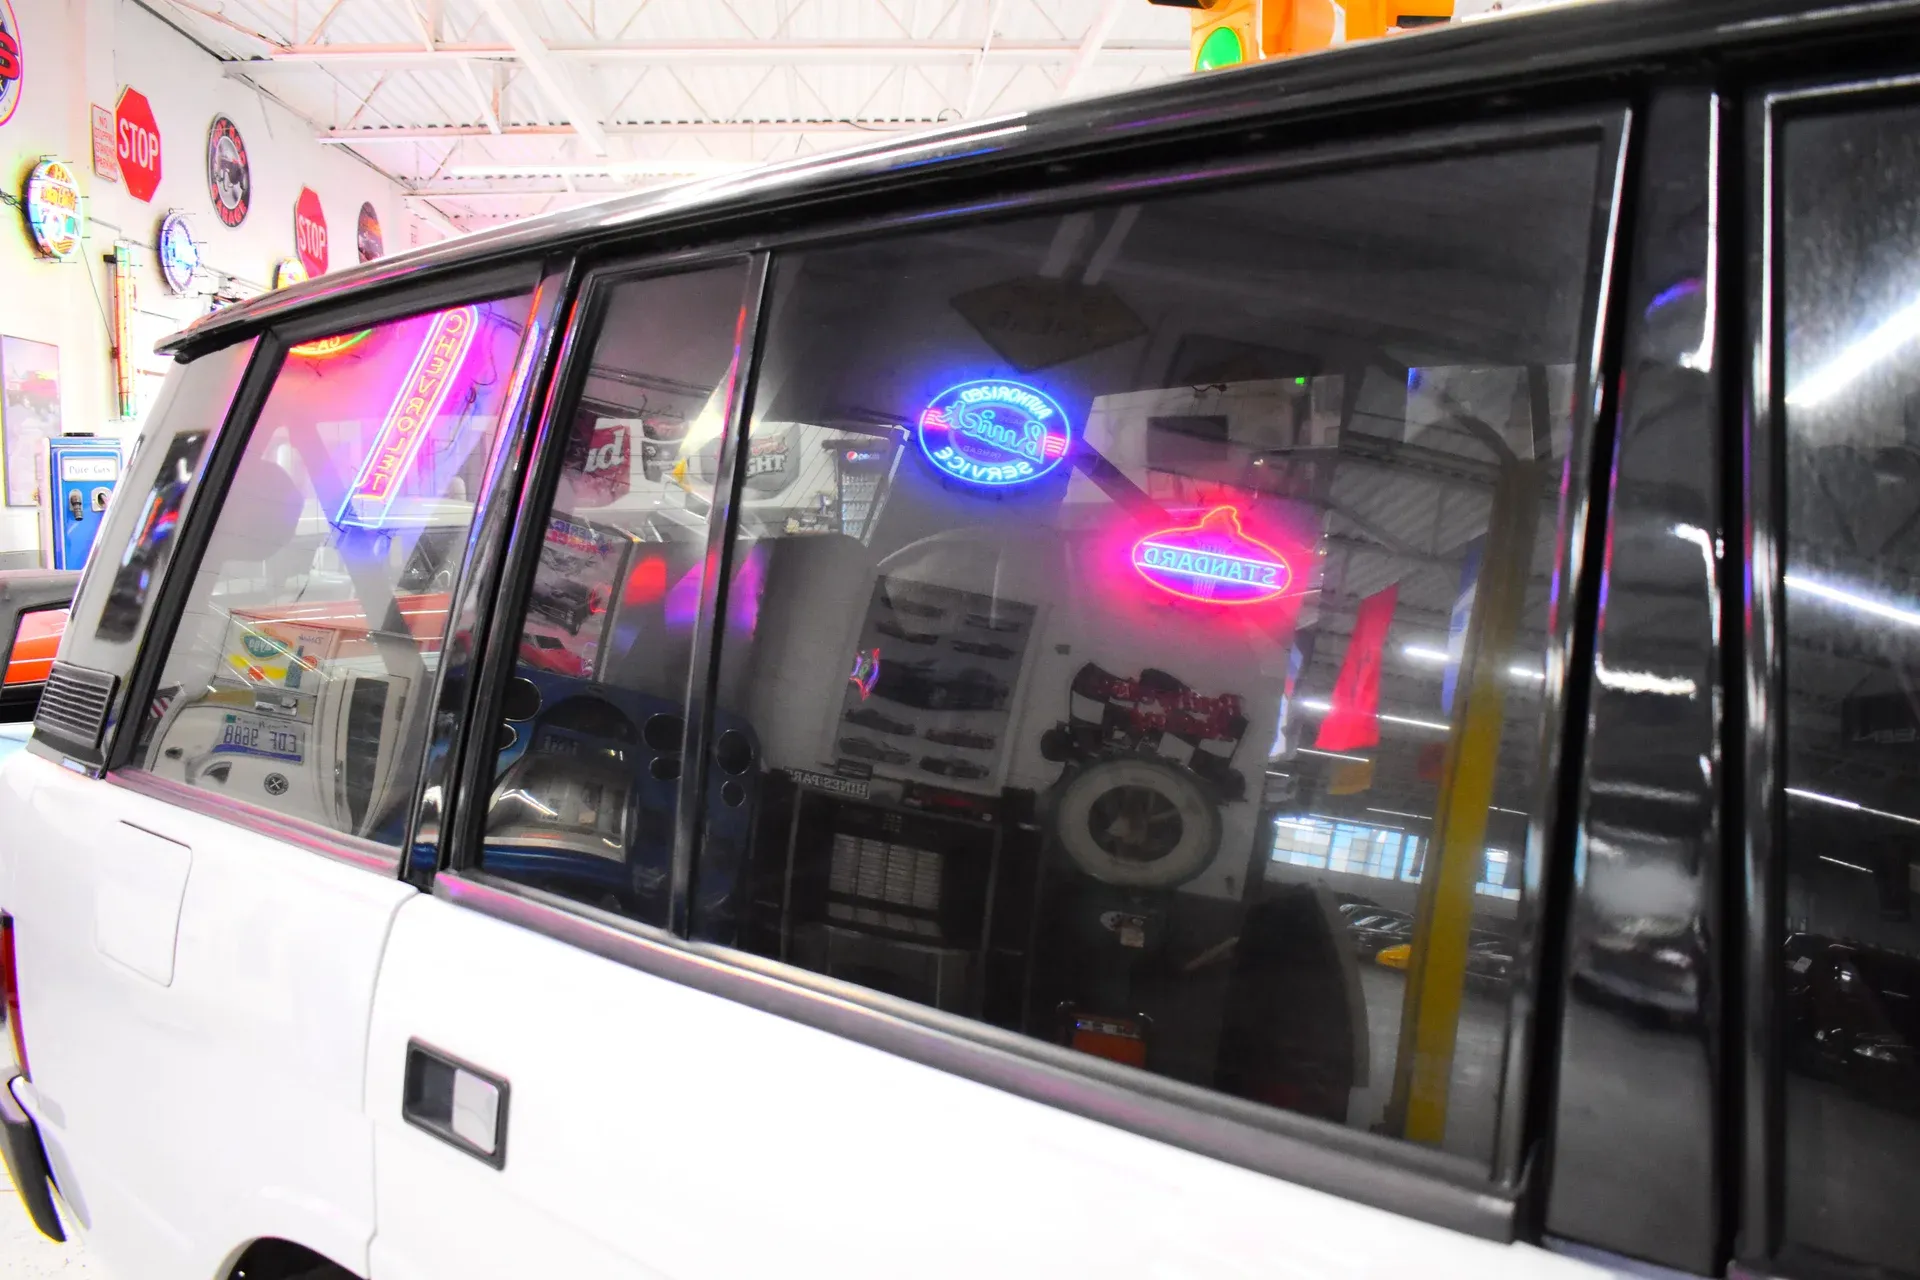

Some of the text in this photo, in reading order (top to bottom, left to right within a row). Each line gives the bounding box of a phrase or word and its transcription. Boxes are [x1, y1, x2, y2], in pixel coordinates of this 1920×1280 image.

[118, 117, 159, 171] STOP
[212, 183, 247, 226] GARAGE
[298, 214, 326, 260] STOP
[583, 428, 625, 473] ud
[746, 454, 786, 477] GHT
